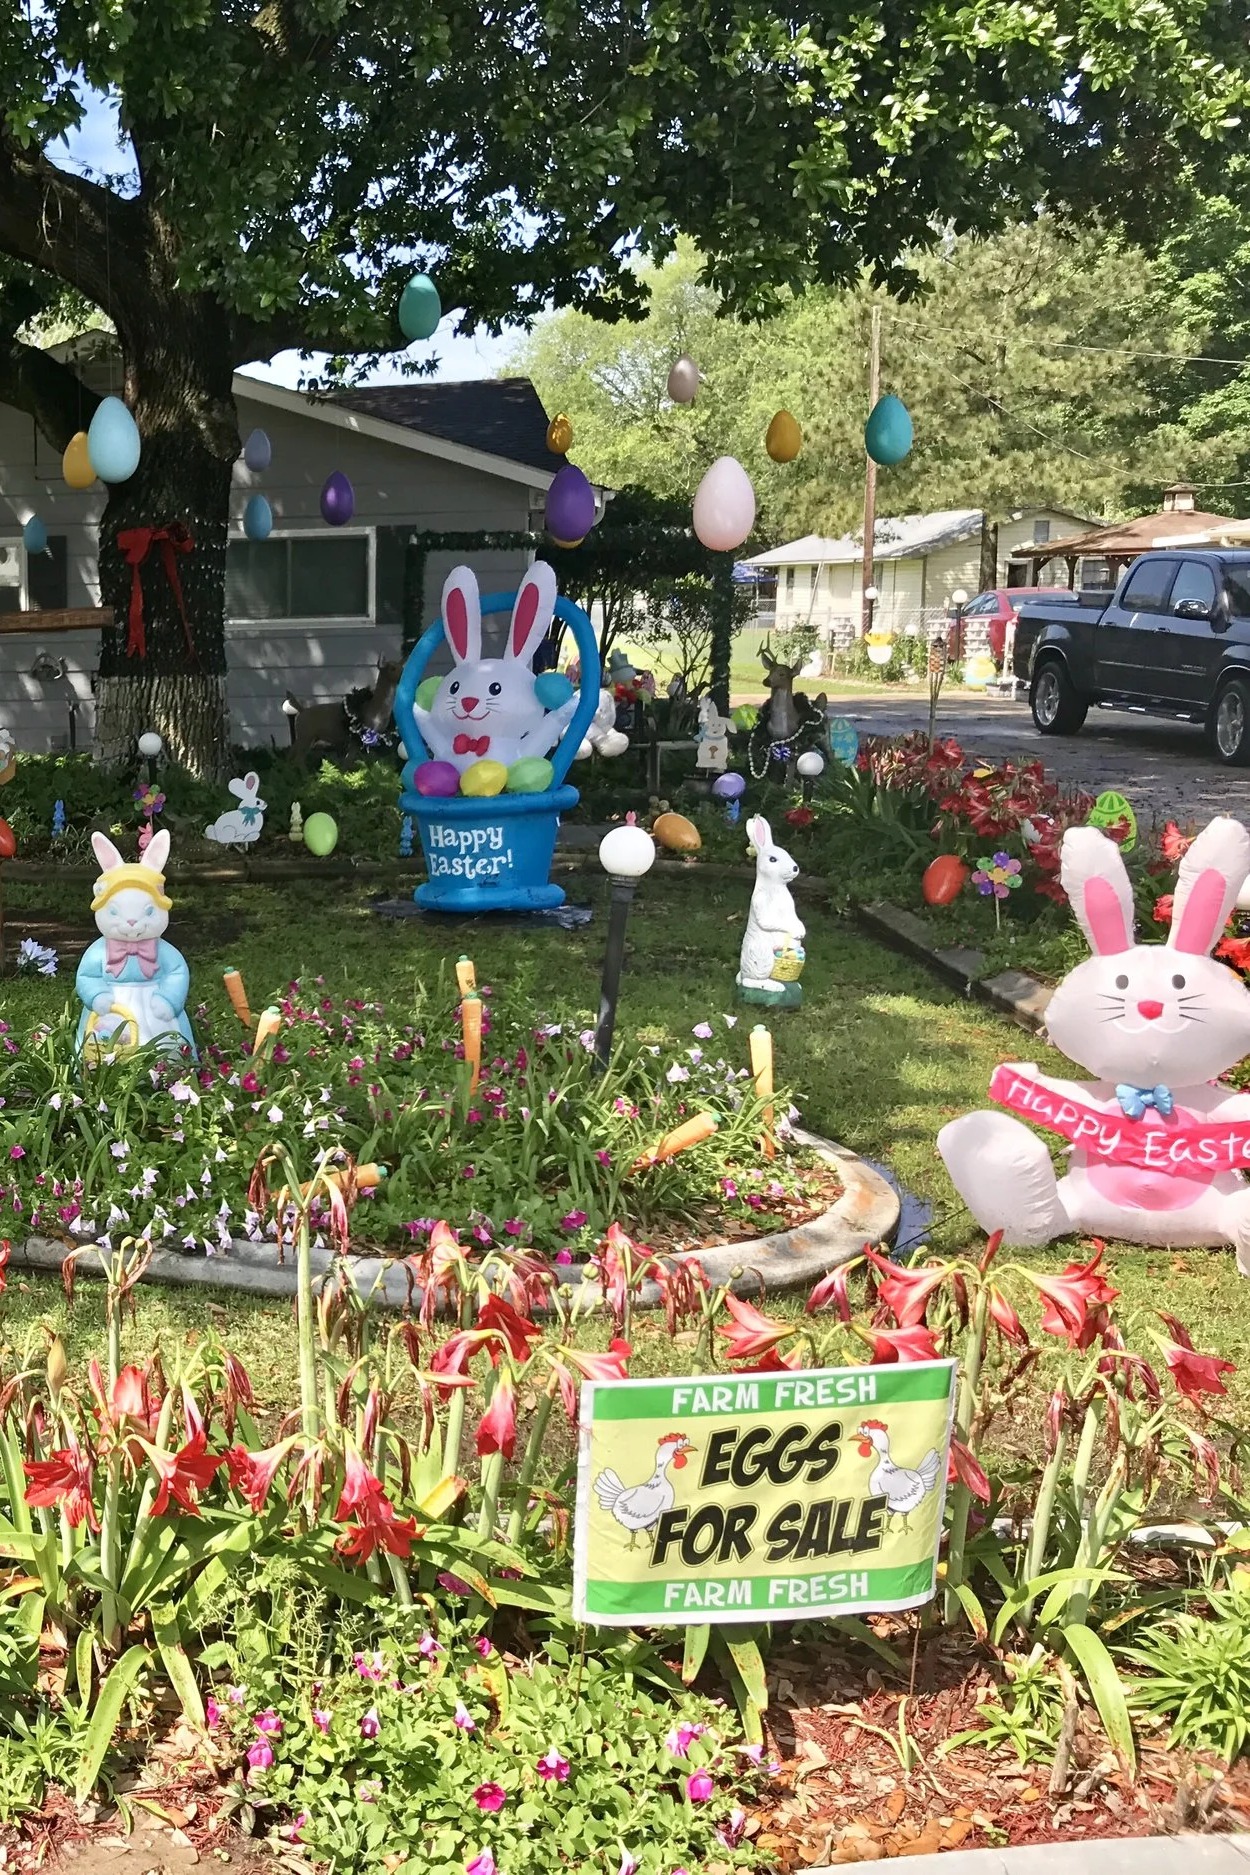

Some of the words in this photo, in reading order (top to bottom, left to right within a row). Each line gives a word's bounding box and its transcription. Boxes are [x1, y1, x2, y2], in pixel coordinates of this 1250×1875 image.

[428, 824, 503, 855] Happy
[428, 850, 514, 880] Easter!
[672, 1383, 759, 1415] FARM
[775, 1375, 877, 1407] FRESH
[699, 1420, 844, 1490] EGGS
[650, 1503, 760, 1568] FOR
[763, 1495, 890, 1562] SALE
[664, 1579, 752, 1608] FARM
[768, 1572, 869, 1604] FRESH
